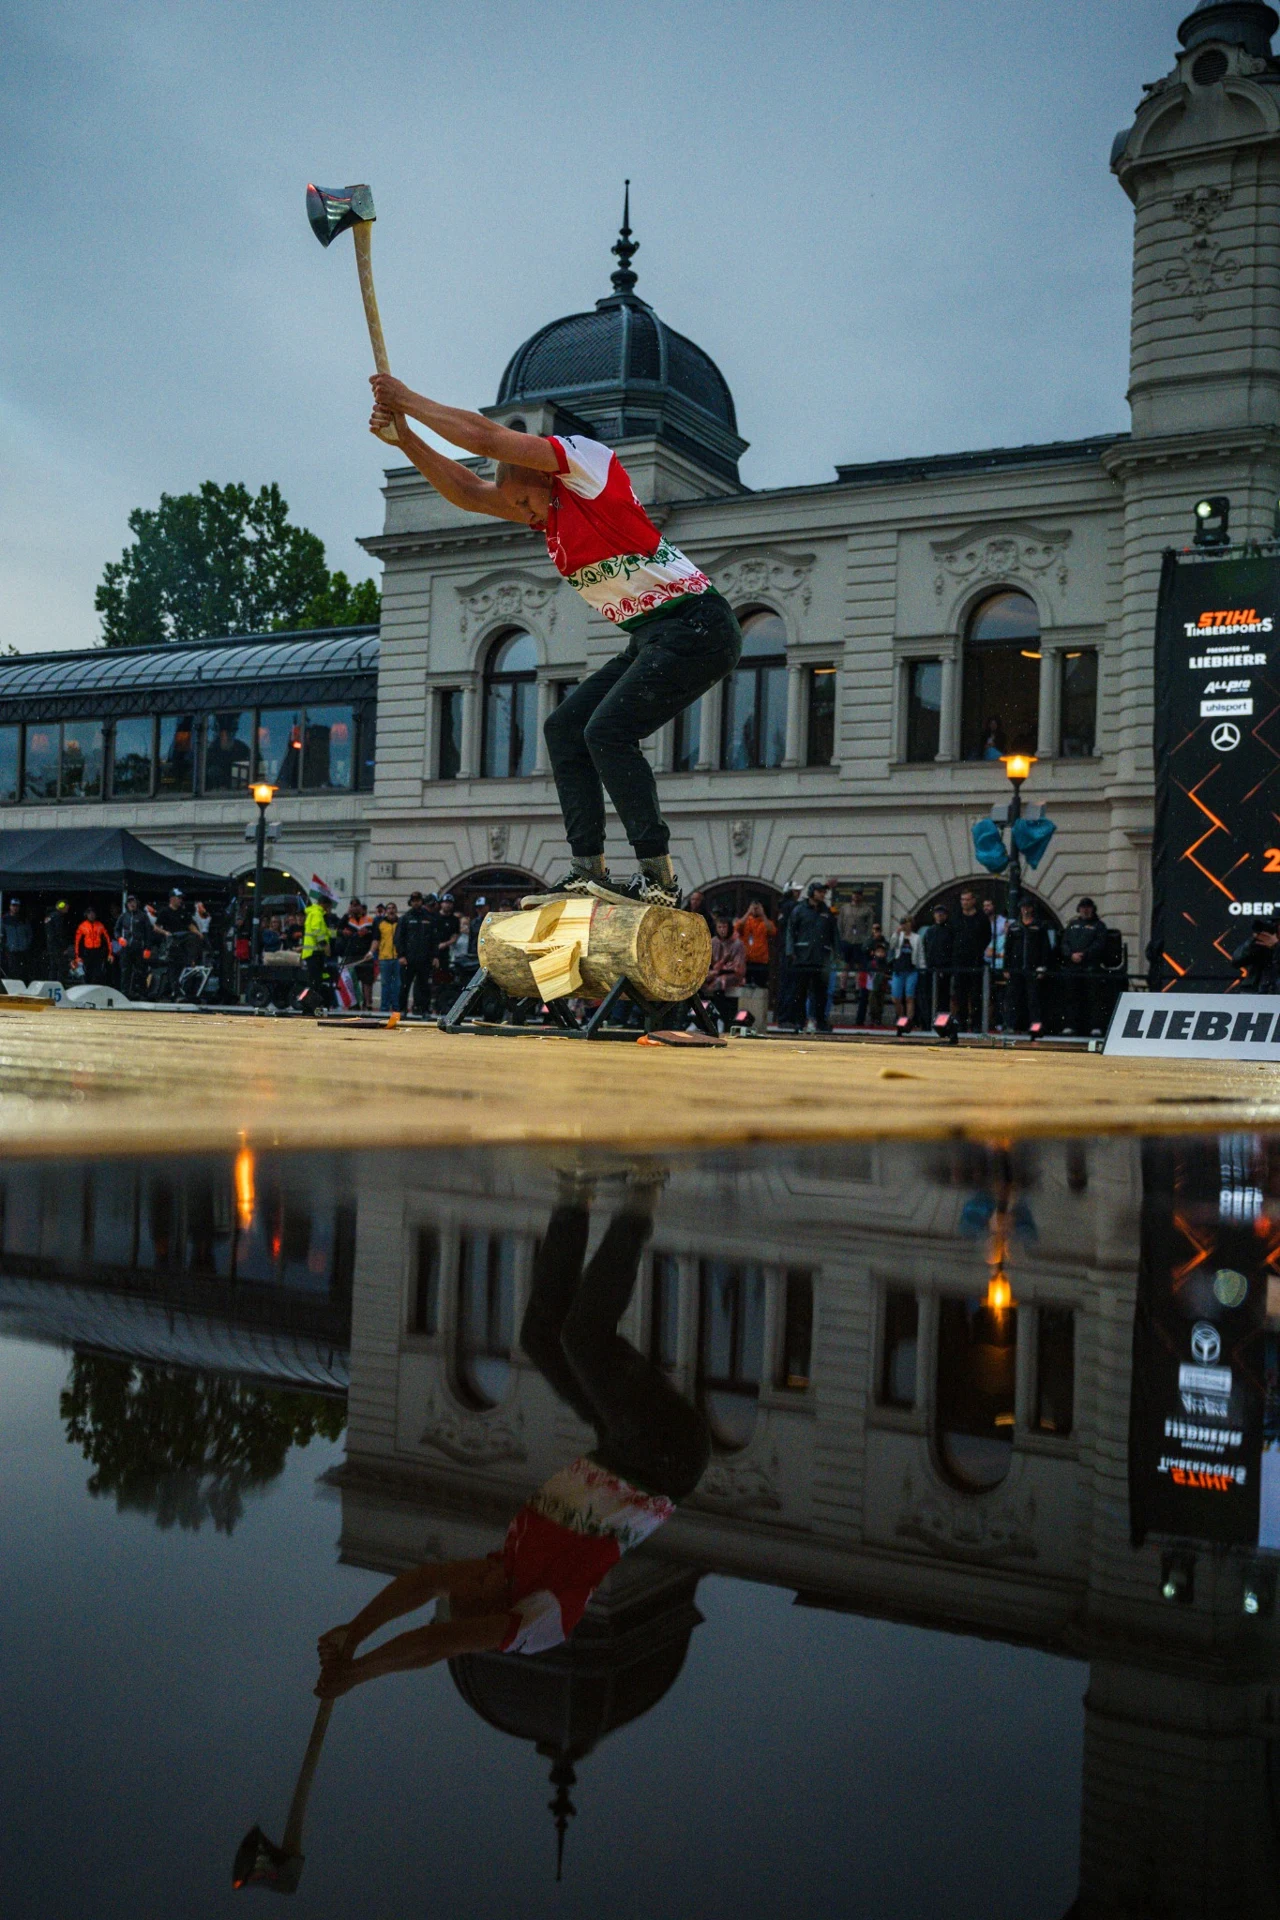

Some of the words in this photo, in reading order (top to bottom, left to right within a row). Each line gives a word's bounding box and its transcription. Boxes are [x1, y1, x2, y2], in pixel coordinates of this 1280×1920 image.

[1198, 608, 1261, 628] STIHL
[1189, 653, 1267, 669] LIEBHERR
[1206, 702, 1247, 712] uhlsport
[48, 988, 62, 1002] 15
[1121, 1009, 1280, 1043] LIEBH
